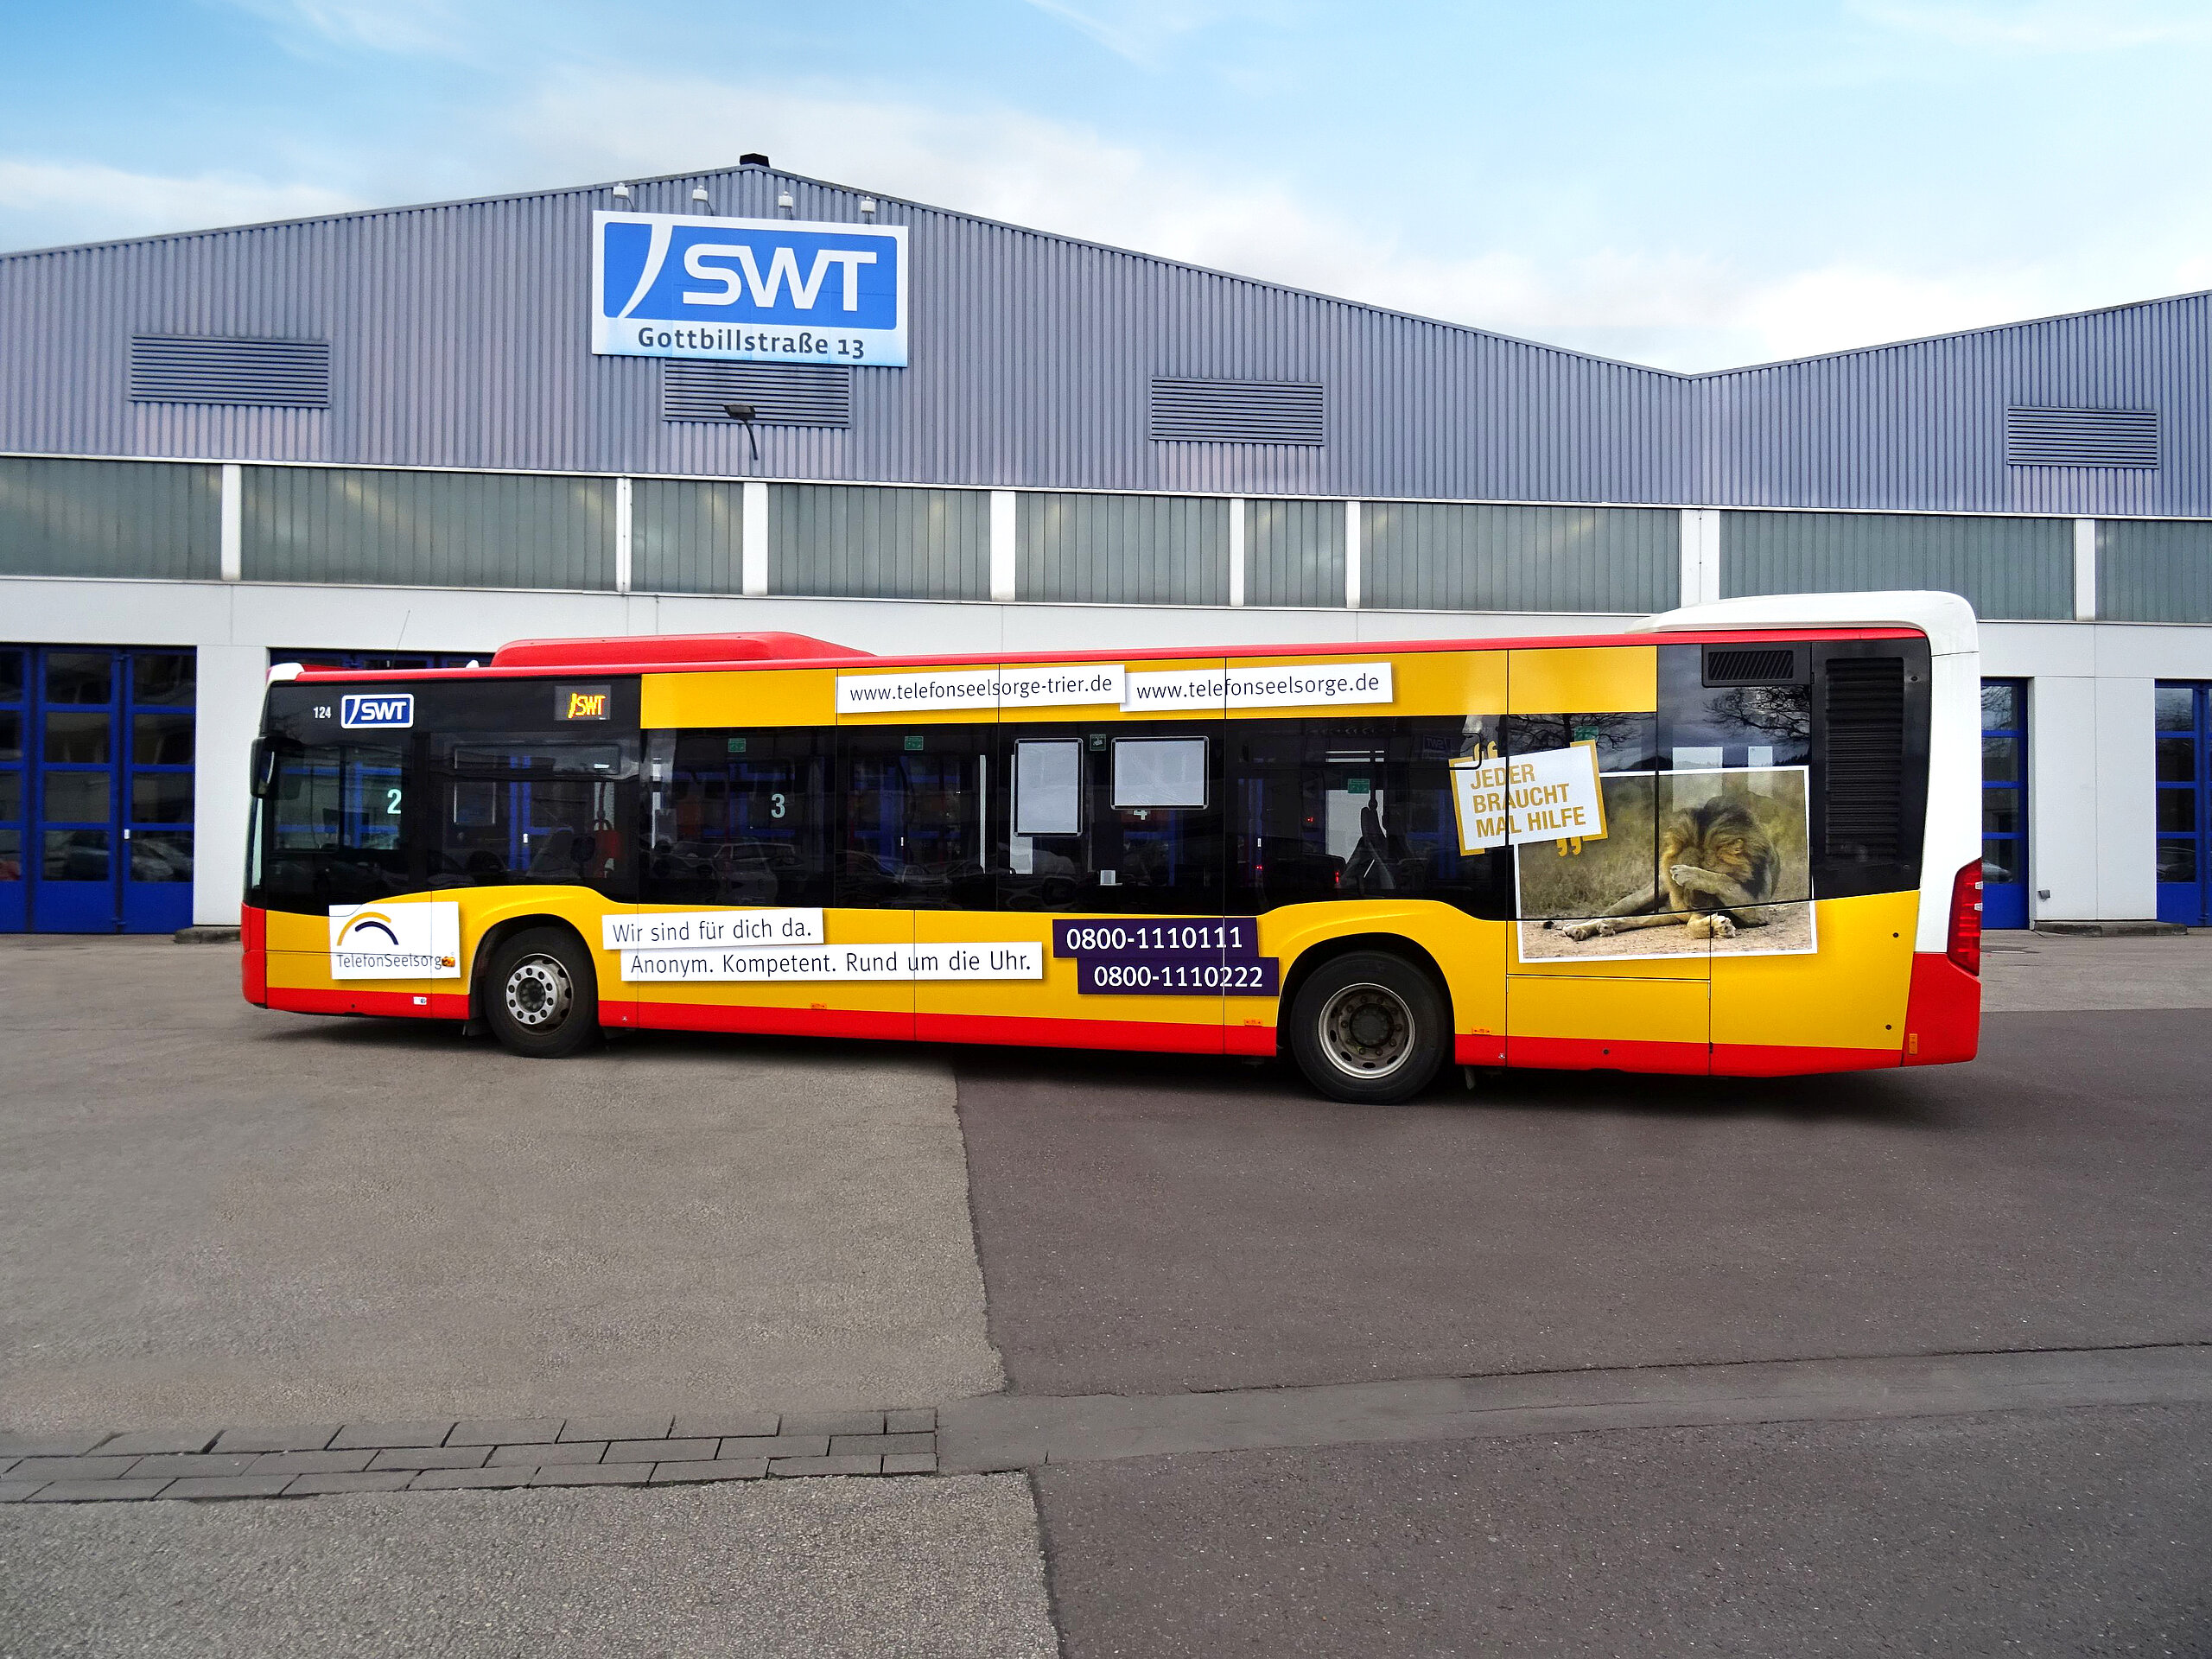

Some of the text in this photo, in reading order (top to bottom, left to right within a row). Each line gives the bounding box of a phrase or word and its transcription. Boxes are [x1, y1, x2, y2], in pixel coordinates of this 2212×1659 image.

[683, 244, 877, 311] SWT
[638, 327, 864, 359] Gottbillstraße 13
[849, 674, 1112, 702] www.telefonseelsorge-trier.de
[1136, 673, 1379, 699] www.telefonseelsorge.de
[313, 706, 332, 719] 124
[360, 701, 407, 721] SWT
[1471, 763, 1535, 790] JEDER
[387, 788, 402, 814] 2
[771, 793, 785, 818] 3
[1472, 783, 1570, 814] BRAUCHT
[1476, 806, 1586, 838] MAL HILFE
[613, 917, 812, 943] Wir sind für dich da.
[1066, 926, 1243, 950] 0800-1110111
[336, 953, 455, 969] TelefonSeelsorg
[631, 950, 1031, 978] Anonym. Kompetent. Rund um die Uhr.
[1094, 965, 1263, 988] 0800-1110222
